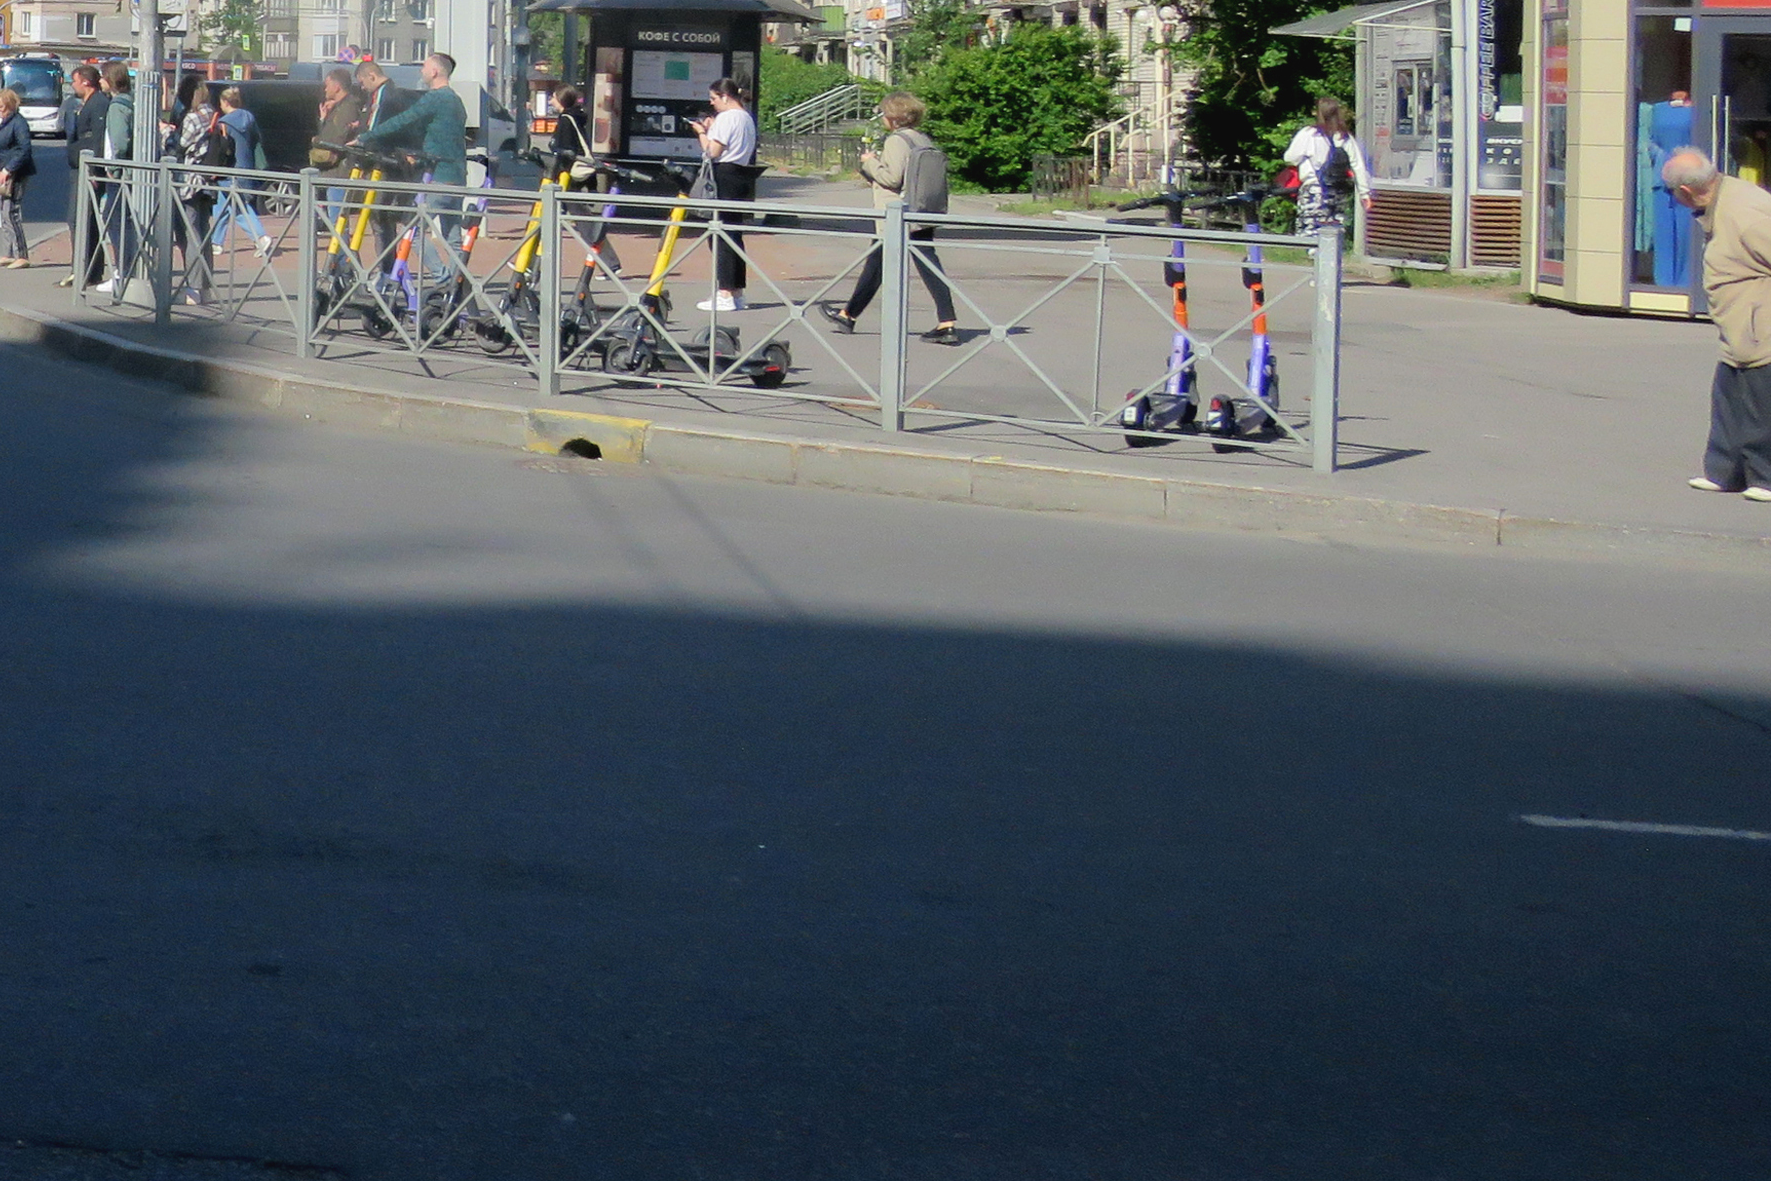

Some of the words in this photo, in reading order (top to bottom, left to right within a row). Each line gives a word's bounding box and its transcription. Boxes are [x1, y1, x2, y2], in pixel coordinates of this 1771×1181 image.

[638, 31, 670, 41] КОФЕ
[672, 32, 680, 42] С
[682, 32, 721, 43] СОБОЙ
[1480, 42, 1495, 120] COFFEE
